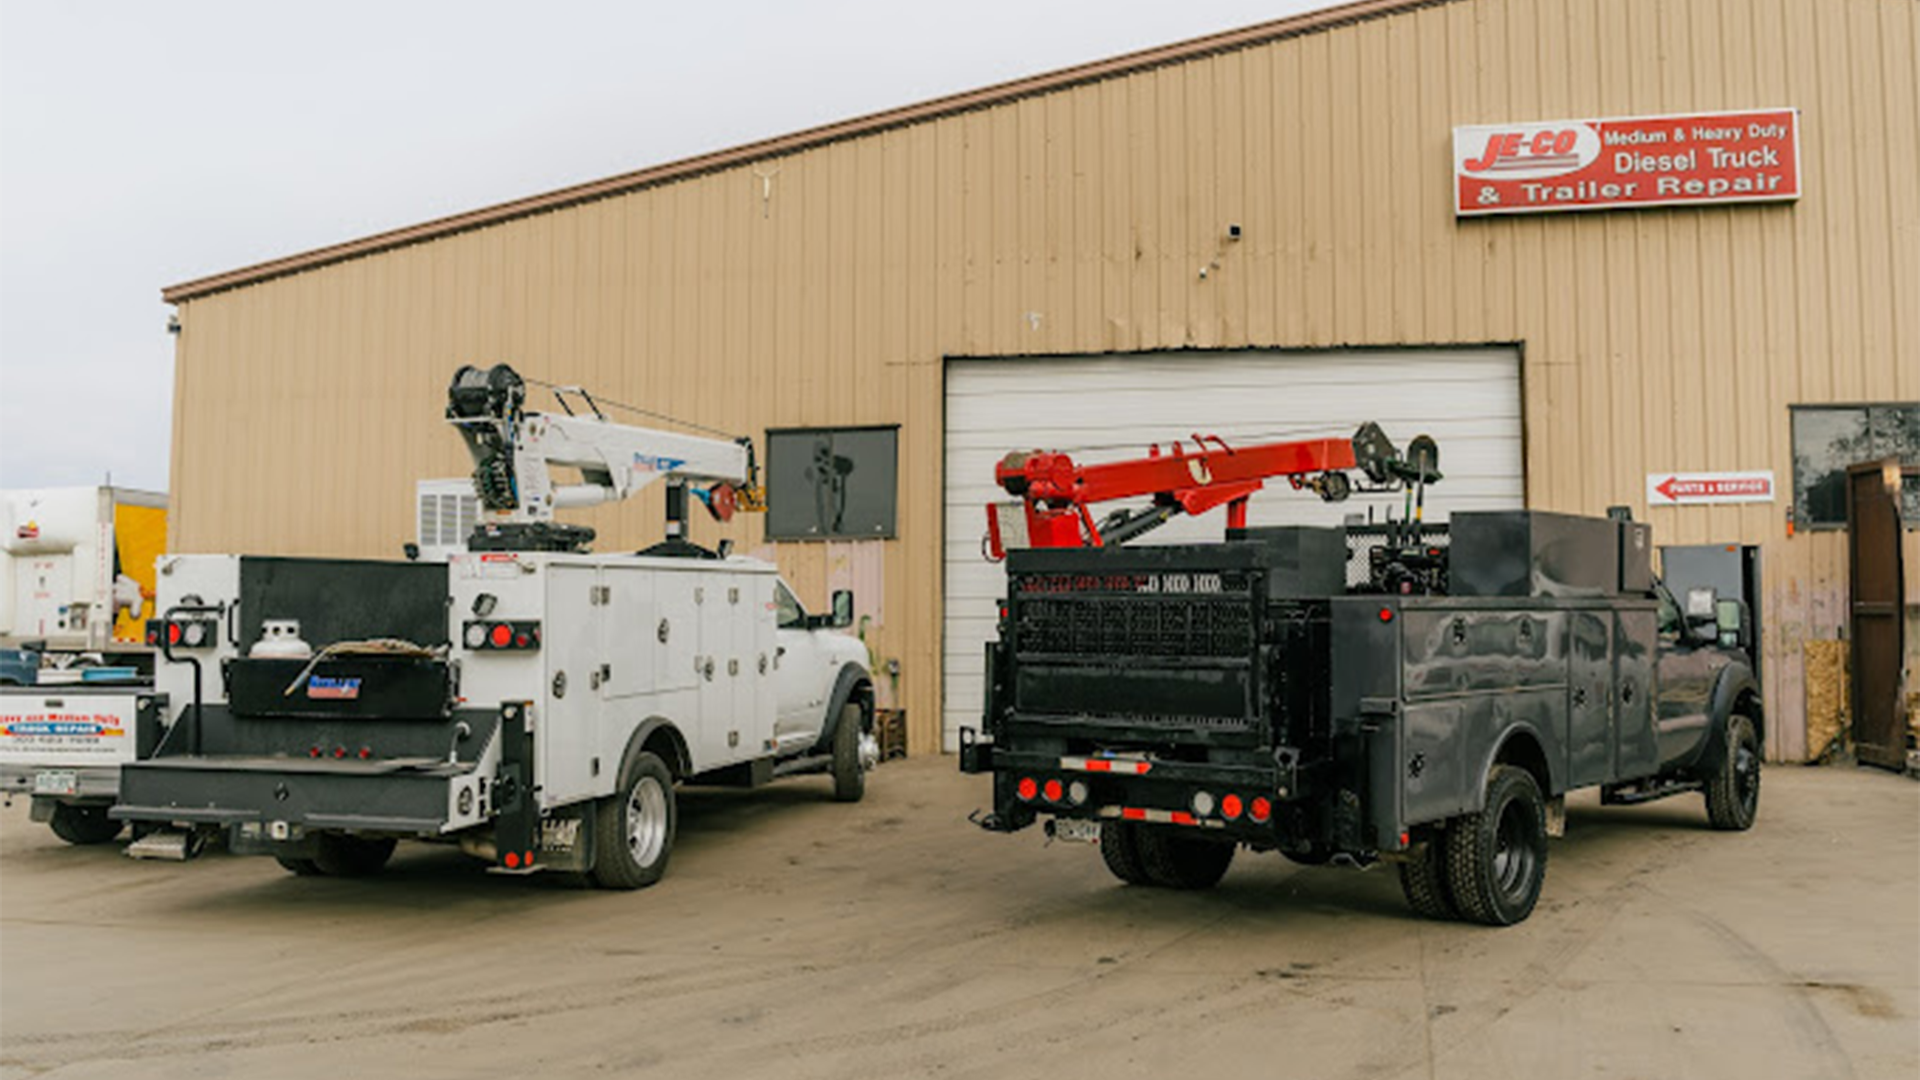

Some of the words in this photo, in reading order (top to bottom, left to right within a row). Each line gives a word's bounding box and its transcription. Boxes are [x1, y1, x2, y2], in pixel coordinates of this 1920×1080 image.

[1604, 128, 1667, 146] Medium
[1673, 127, 1685, 143] &
[1692, 126, 1743, 143] Heavy
[1748, 123, 1788, 141] Duty
[1463, 129, 1578, 172] JE-CO
[1614, 148, 1697, 174] Diesel
[1706, 145, 1779, 169] Truck
[1477, 185, 1501, 204] &
[1520, 180, 1639, 203] Trailer
[1657, 172, 1782, 196] Repair
[1669, 482, 1706, 493] PARTS
[1717, 482, 1763, 493] SERVICE
